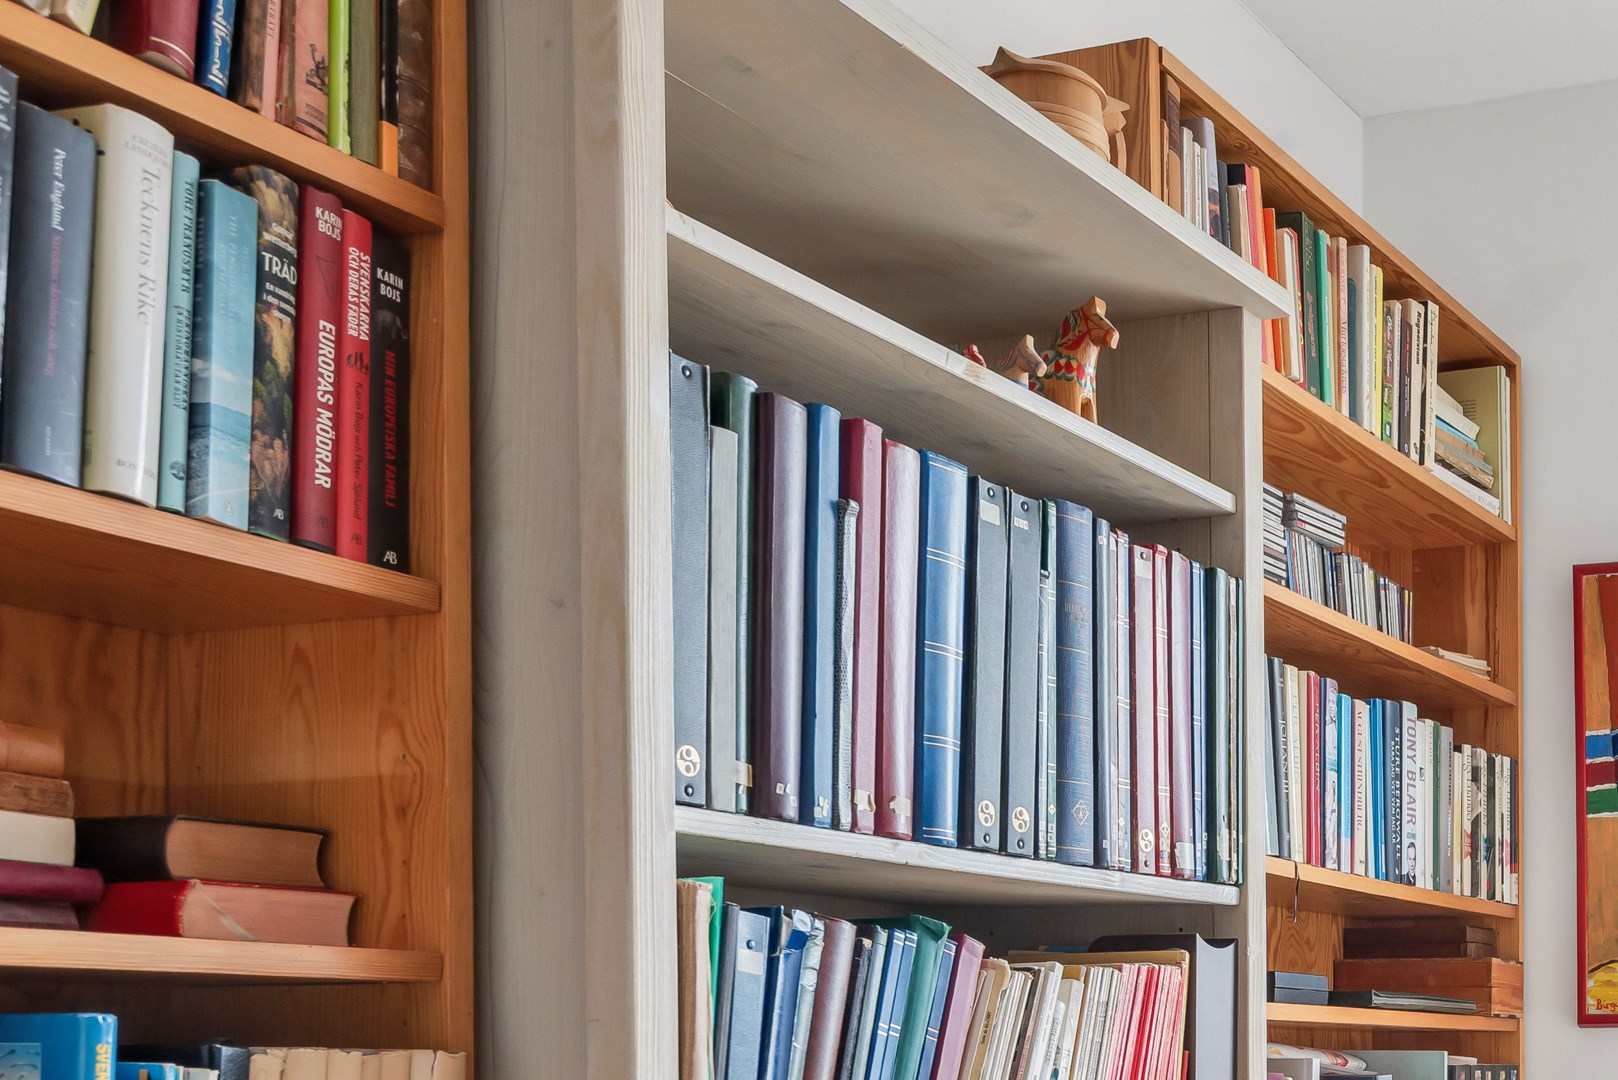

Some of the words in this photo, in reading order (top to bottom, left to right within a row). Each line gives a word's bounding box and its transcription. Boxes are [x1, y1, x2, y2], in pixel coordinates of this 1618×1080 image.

[53, 148, 67, 178] Peter
[51, 181, 65, 231] Englund
[183, 181, 194, 213] TORE
[140, 166, 162, 270] Tecknens
[315, 206, 342, 230] KARIN
[318, 221, 341, 241] BOJS
[349, 247, 360, 269] OCH
[348, 269, 359, 303] DERAS
[377, 267, 403, 290] KARIN
[380, 283, 401, 303] BOJS
[138, 272, 157, 325] Rike
[359, 252, 371, 341] SVENSKARNA
[317, 320, 336, 406] EUROPAS
[385, 350, 396, 376] MIN
[354, 381, 363, 406] Karin
[385, 379, 396, 457] EUROPEISKA
[315, 408, 336, 489] MÖDRAR
[355, 433, 363, 452] och
[1278, 718, 1288, 772] JOHAN
[1405, 717, 1417, 765] TONY
[1405, 769, 1417, 826] BLAIR
